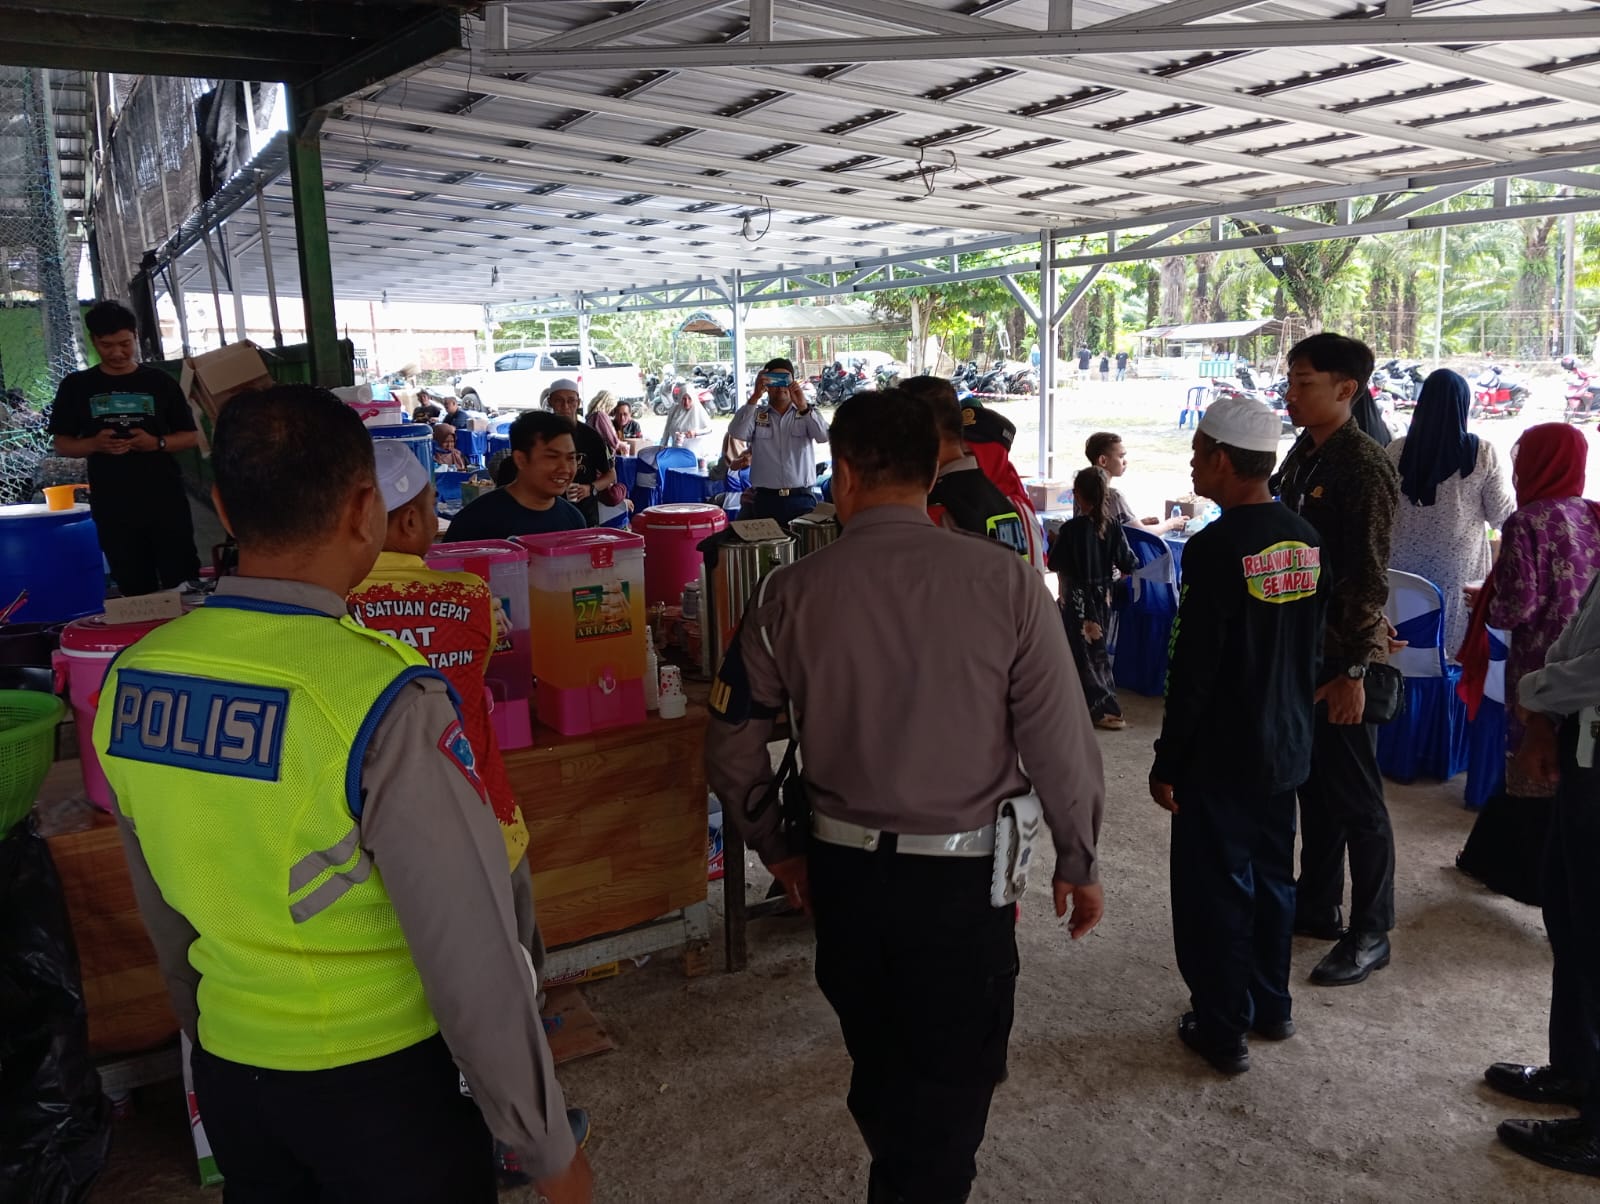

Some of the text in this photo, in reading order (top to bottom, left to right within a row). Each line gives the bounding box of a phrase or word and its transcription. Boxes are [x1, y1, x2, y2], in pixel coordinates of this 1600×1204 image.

[366, 600, 424, 618] SATUAN
[429, 601, 471, 622] CEPAT
[576, 600, 598, 622] 27
[428, 650, 473, 669] TAPIN
[114, 683, 278, 764] POLISI
